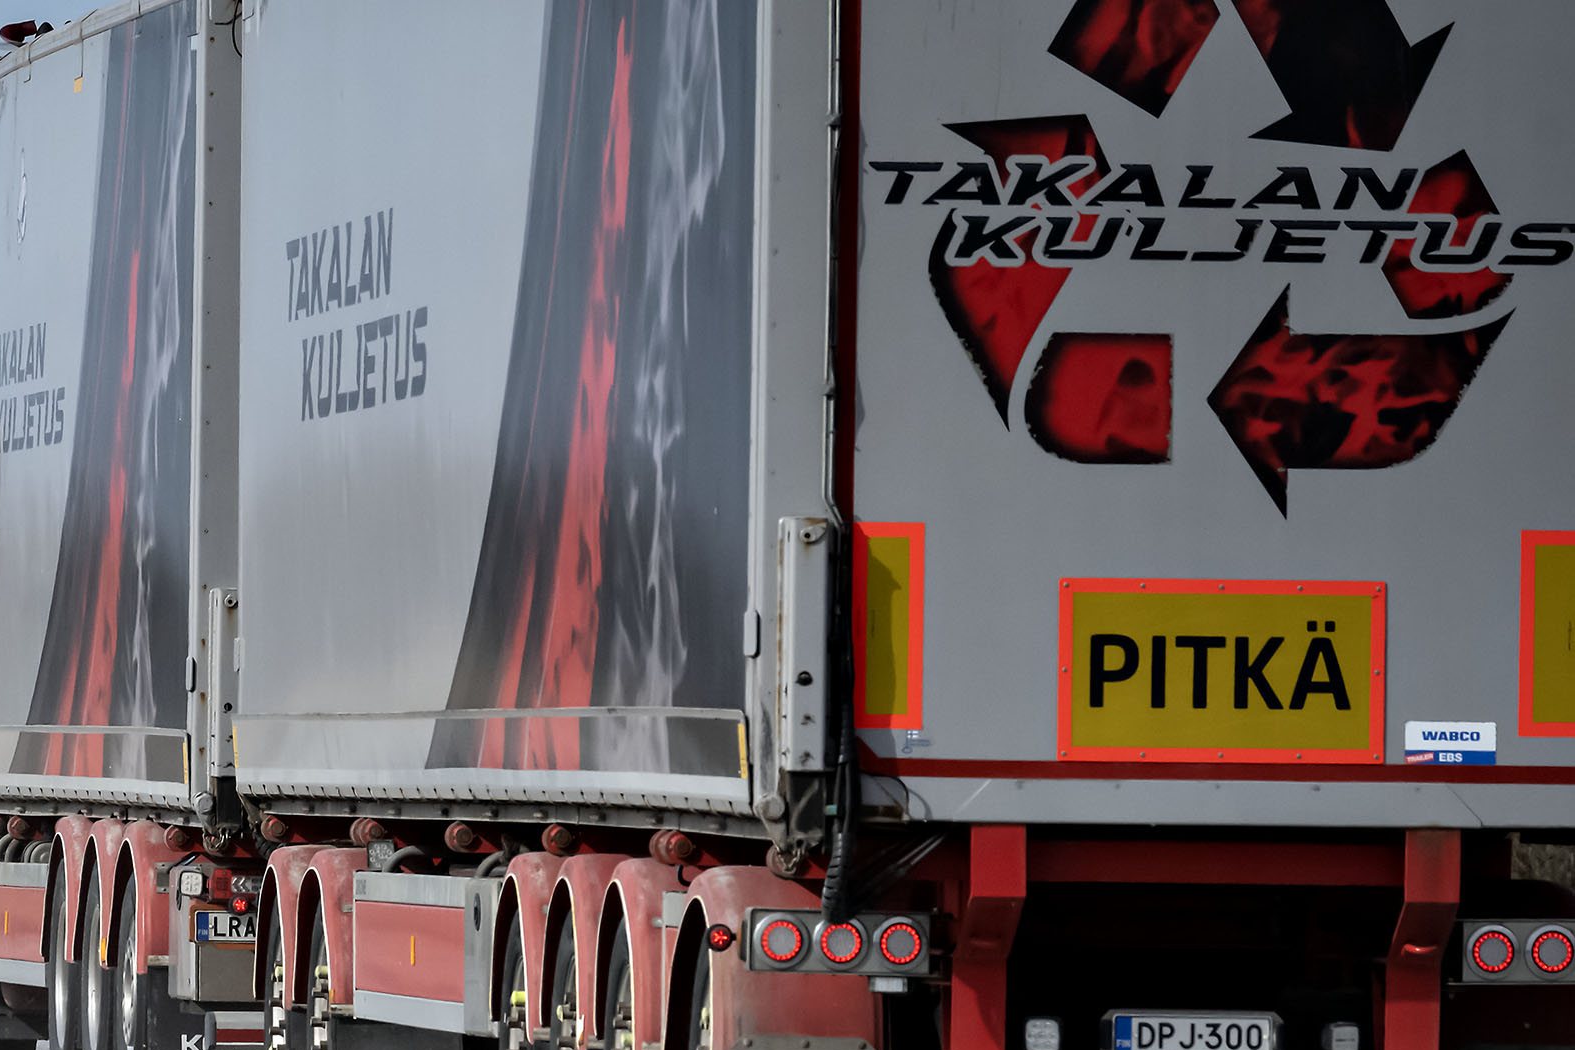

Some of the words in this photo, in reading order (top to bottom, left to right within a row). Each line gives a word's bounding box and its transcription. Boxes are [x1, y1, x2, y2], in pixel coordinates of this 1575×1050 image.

[869, 161, 1419, 211] TAKALAN
[286, 207, 394, 322] TAKALAN
[952, 215, 1575, 266] KULJETUS
[301, 306, 428, 422] KULJETUS
[1089, 620, 1351, 711] PITKÄ
[1422, 731, 1480, 741] WABCO
[1438, 752, 1463, 762] EBS
[213, 916, 256, 937] LRA
